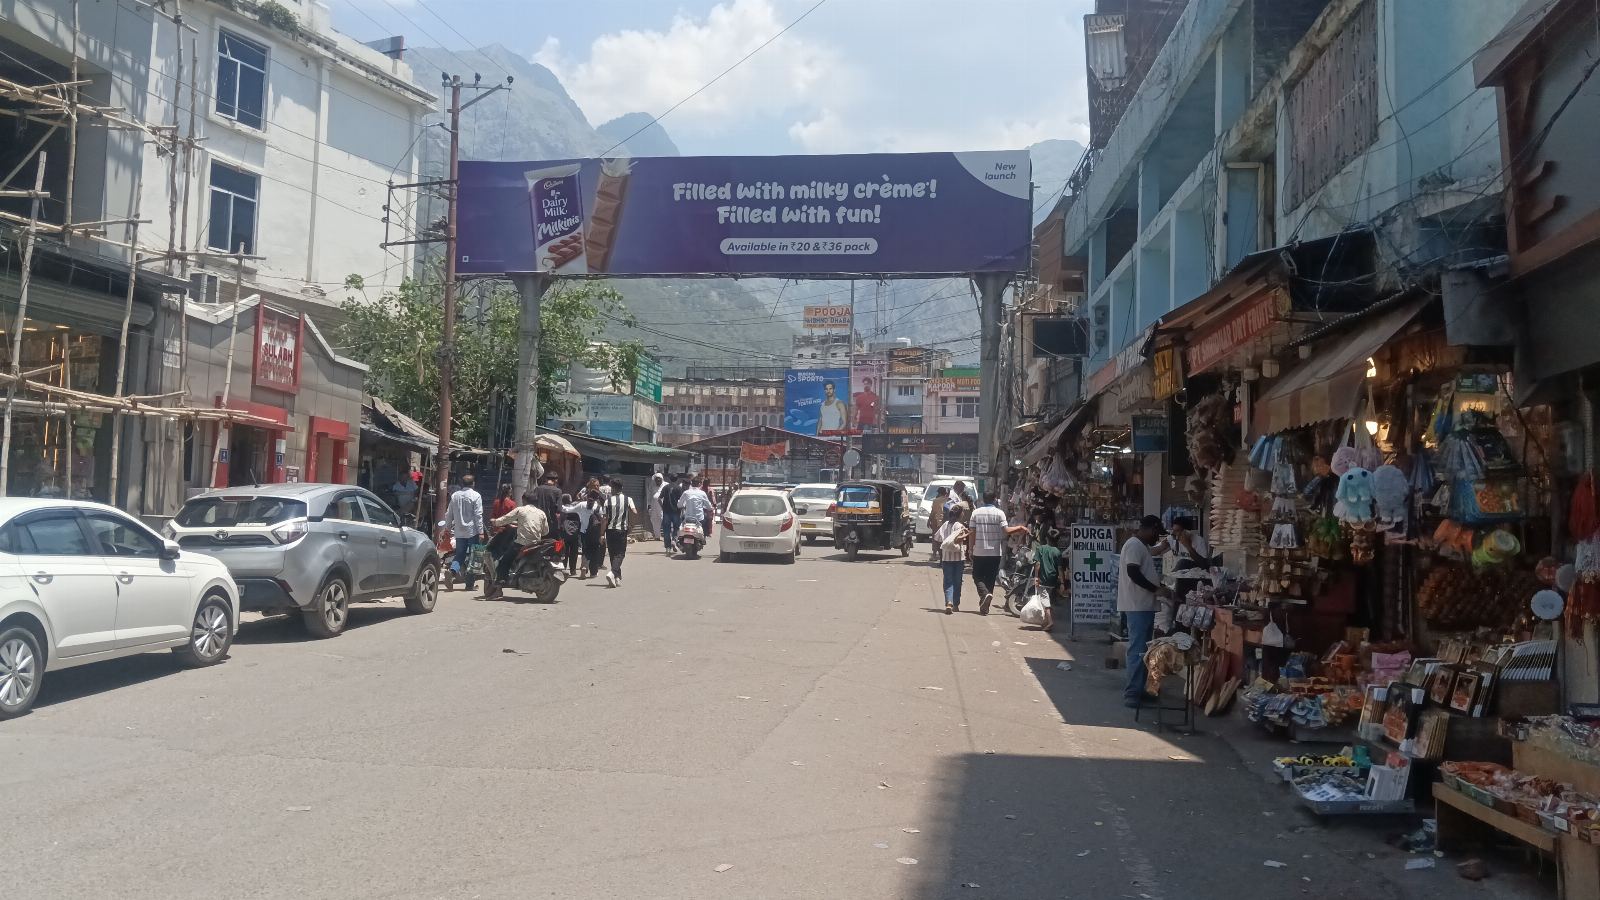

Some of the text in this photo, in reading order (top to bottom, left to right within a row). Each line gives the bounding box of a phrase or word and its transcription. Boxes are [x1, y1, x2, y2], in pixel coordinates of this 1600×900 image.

[995, 162, 1016, 171] New
[985, 171, 1016, 180] launch
[673, 182, 732, 201] Filled
[736, 182, 784, 199] with
[789, 181, 849, 202] milky
[542, 198, 568, 209] Dairy
[544, 207, 566, 217] Milk
[717, 204, 881, 224] Filled with fun!
[537, 215, 580, 241] Milkinis
[727, 242, 777, 251] Available
[778, 242, 789, 251] in
[791, 241, 811, 251] ₹20
[843, 242, 871, 253] pack
[814, 307, 851, 317] POOJA
[263, 342, 293, 363] SULABH
[1073, 527, 1113, 540] DURGA
[1073, 541, 1113, 552] MEDICAL HALL
[1073, 571, 1111, 583] CLINIC
